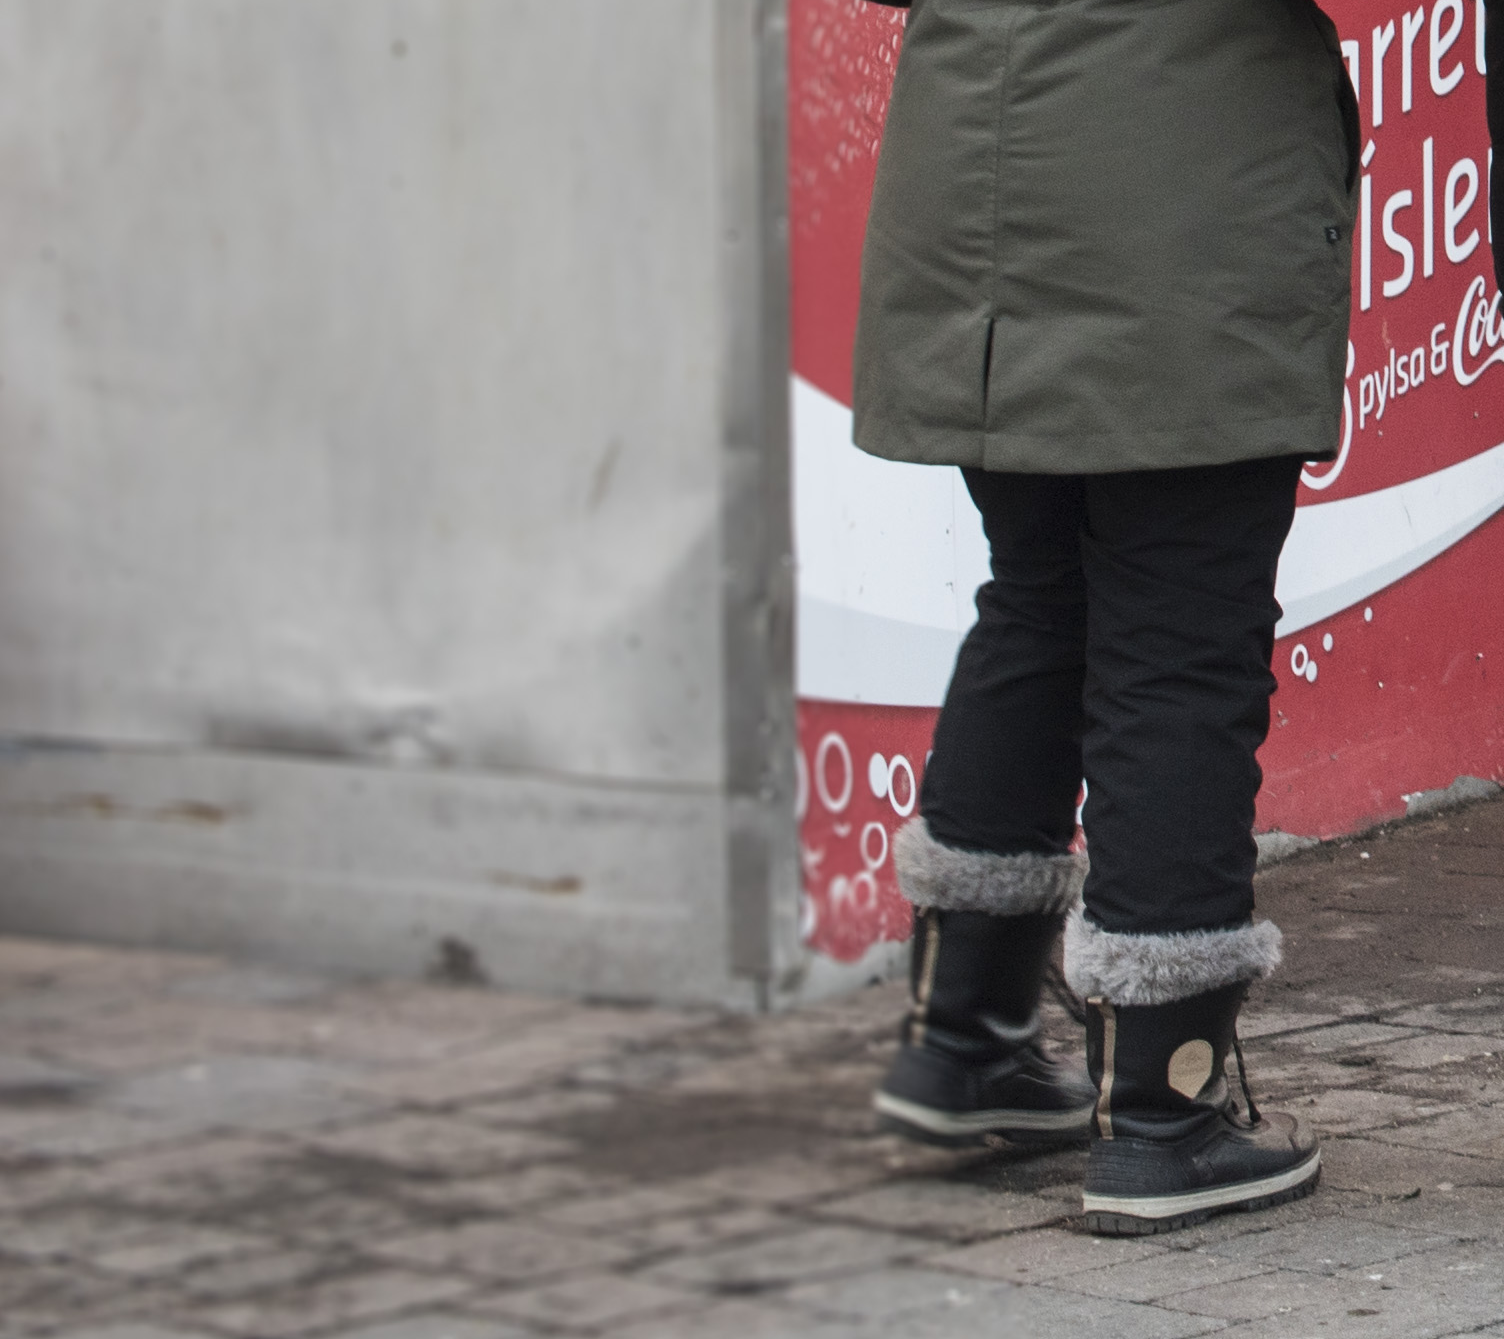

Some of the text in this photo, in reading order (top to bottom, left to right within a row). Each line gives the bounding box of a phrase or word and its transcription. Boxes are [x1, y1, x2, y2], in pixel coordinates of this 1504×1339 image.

[1361, 129, 1492, 311] Ísle
[1360, 348, 1425, 430] pylsa
[1431, 323, 1450, 375] &
